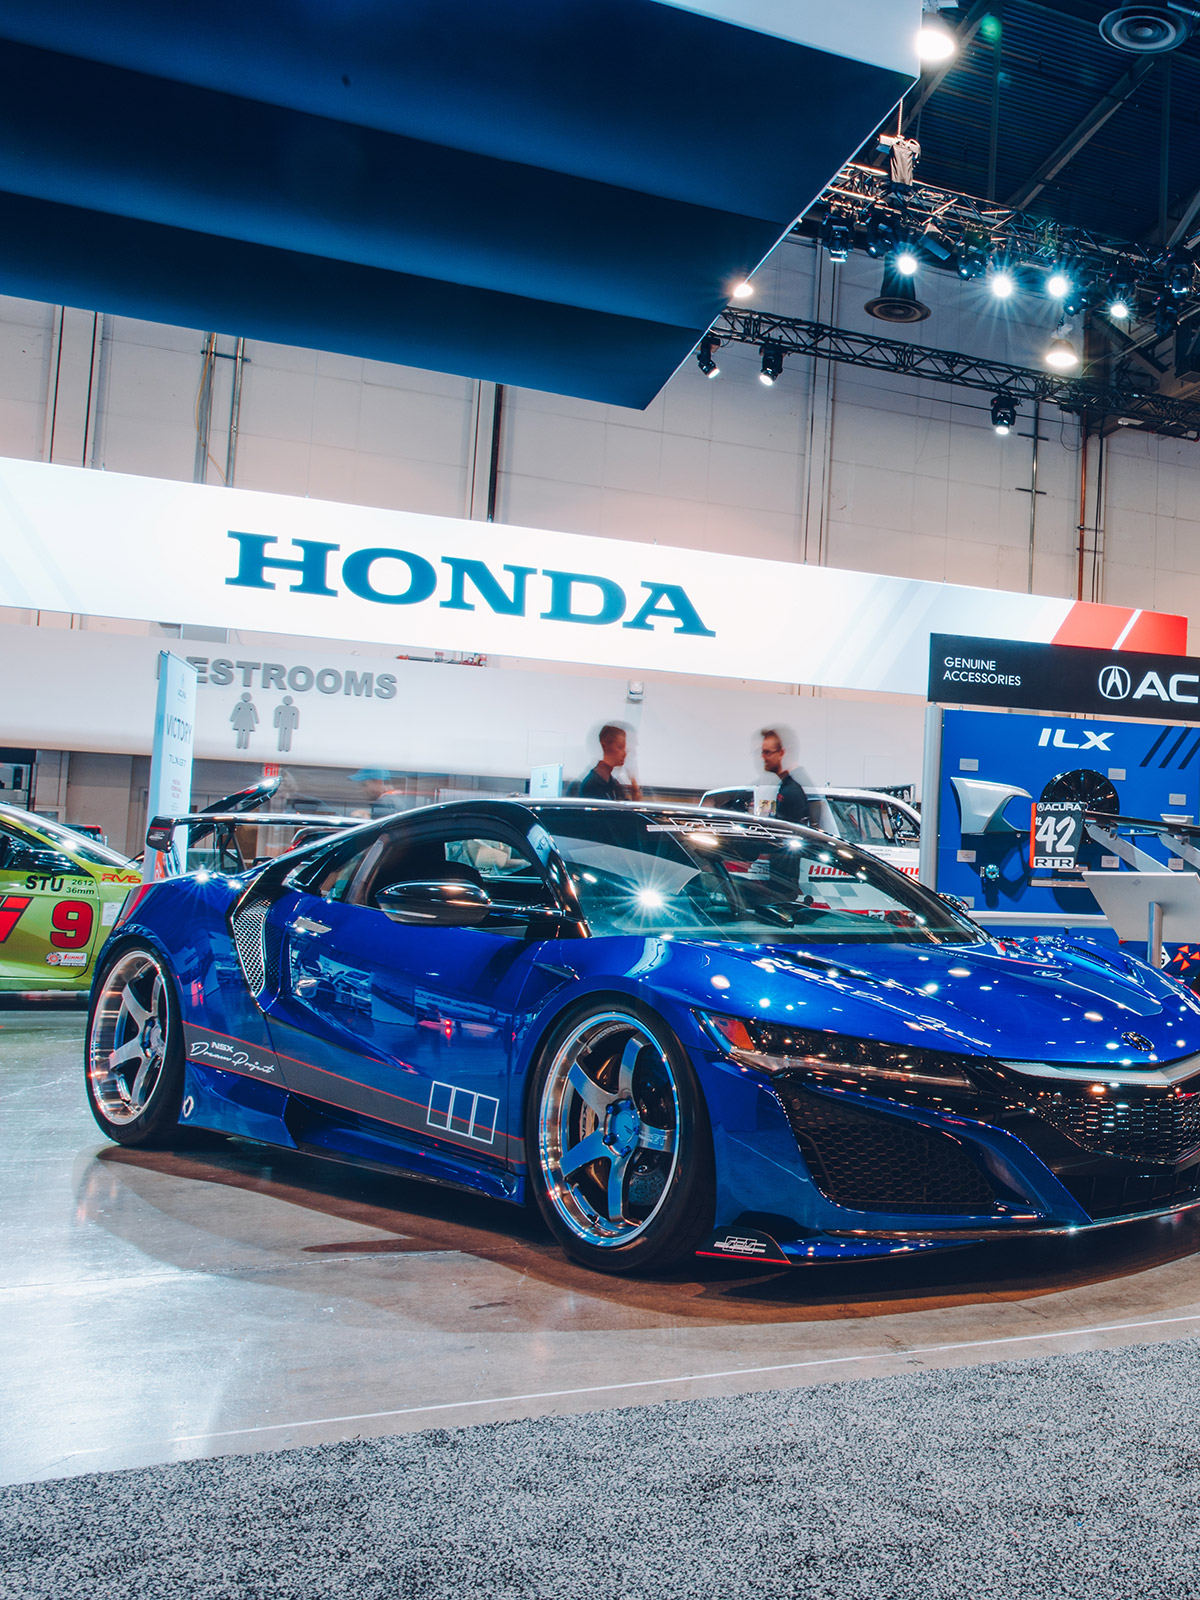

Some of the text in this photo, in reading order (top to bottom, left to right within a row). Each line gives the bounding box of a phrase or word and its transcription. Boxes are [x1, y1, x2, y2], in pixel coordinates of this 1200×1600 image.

[225, 530, 716, 638] HONDA
[944, 656, 997, 671] GENUINE
[157, 653, 398, 699] ESTROOMS
[943, 670, 1022, 686] ACCESSORIES
[1038, 727, 1115, 751] ILX
[1044, 802, 1082, 811] ACURA
[1035, 816, 1076, 853] 42
[1035, 858, 1072, 867] RTR
[25, 875, 65, 892] STU
[101, 873, 142, 884] RV6
[66, 887, 95, 895] 36mm
[49, 900, 94, 950] 9
[211, 1041, 234, 1053] NSX
